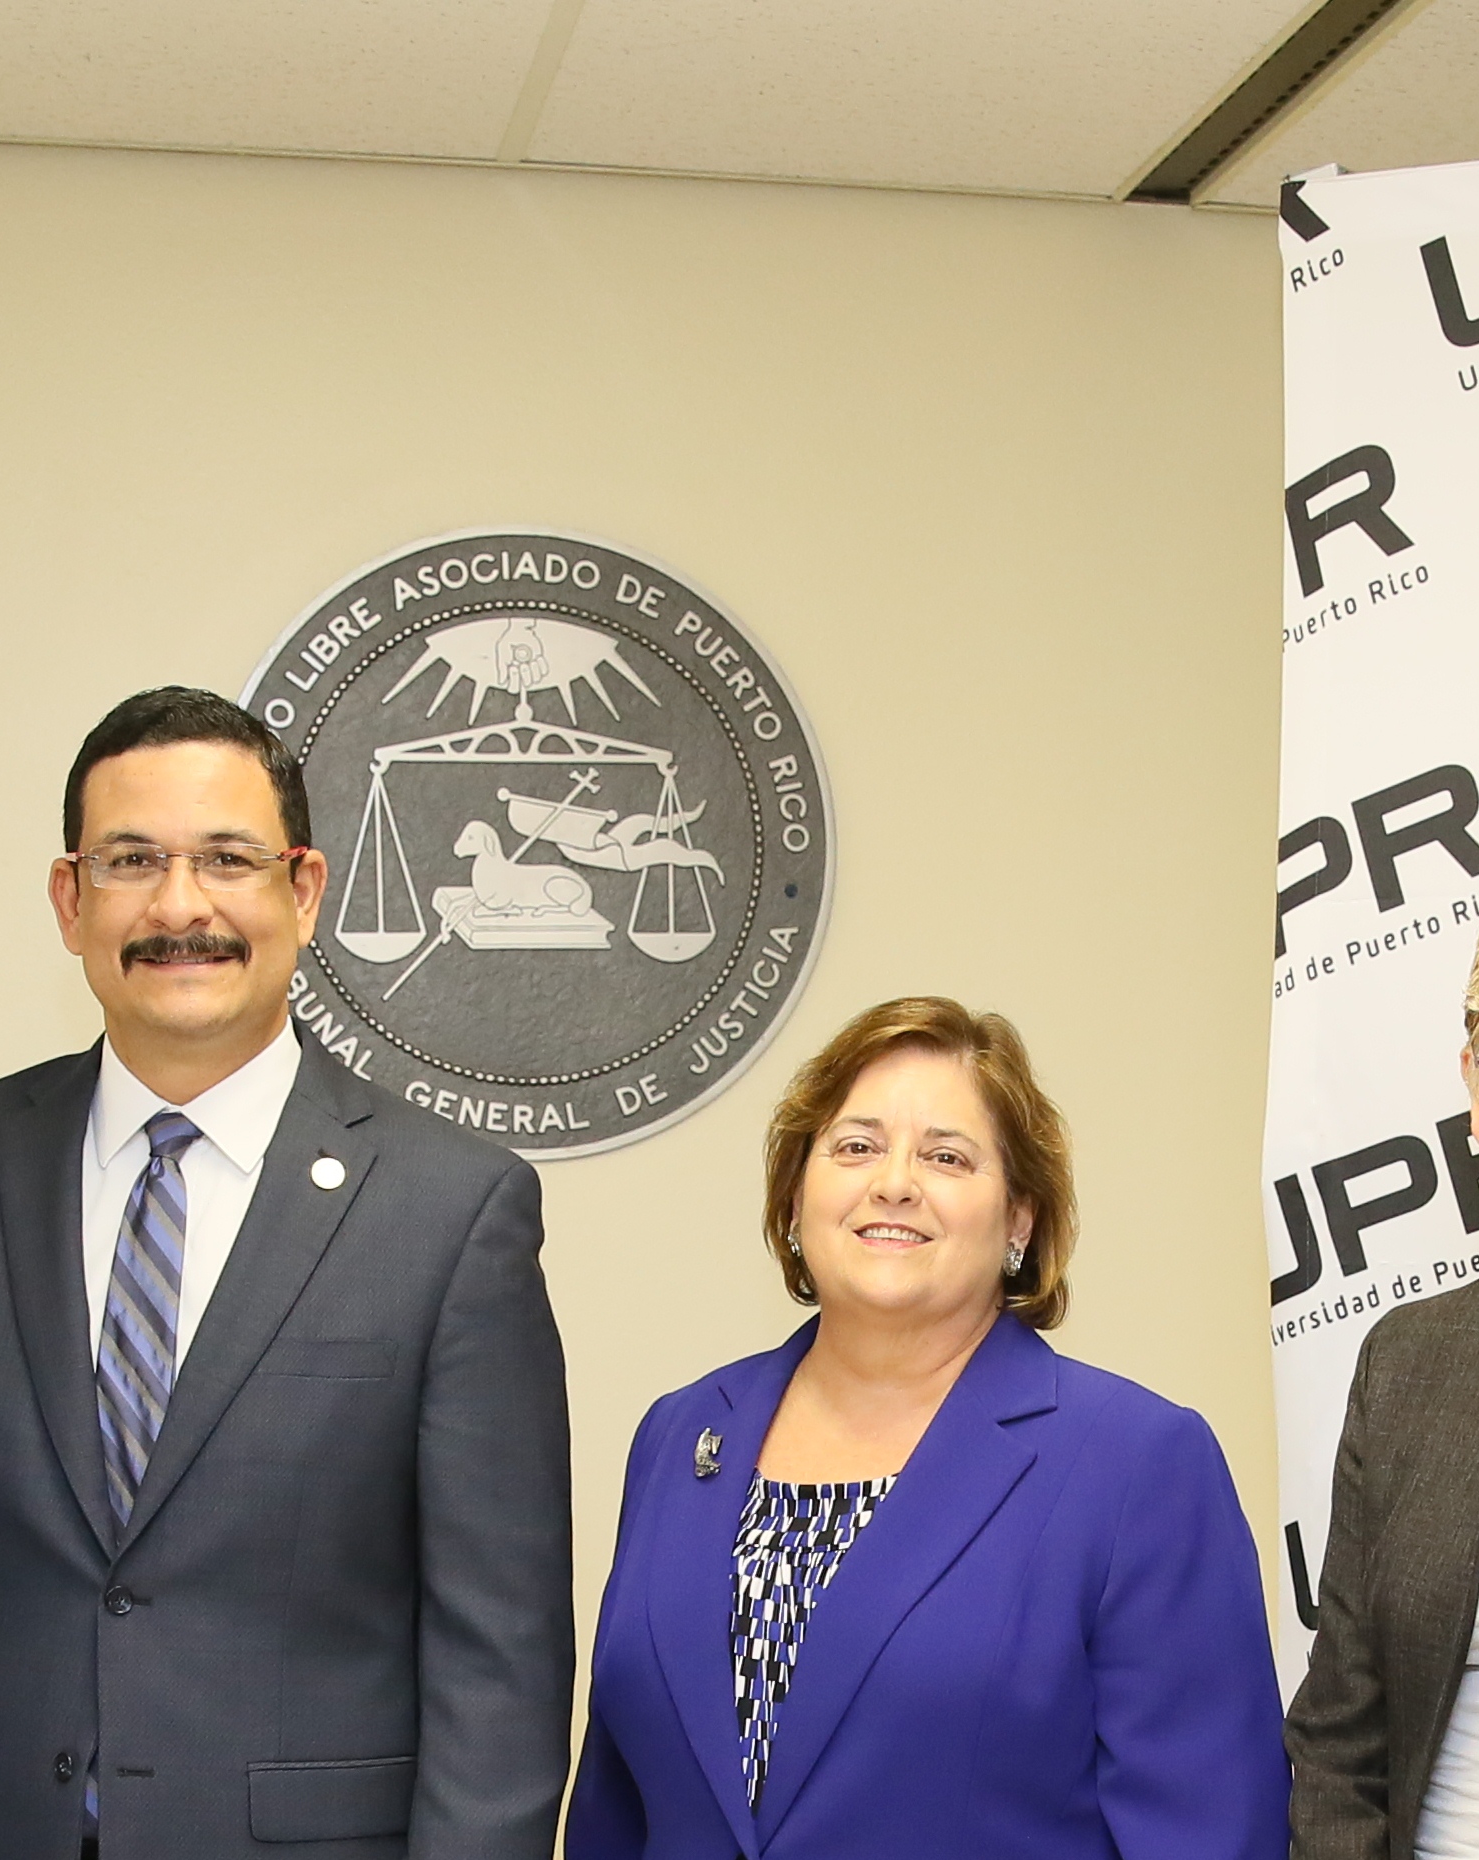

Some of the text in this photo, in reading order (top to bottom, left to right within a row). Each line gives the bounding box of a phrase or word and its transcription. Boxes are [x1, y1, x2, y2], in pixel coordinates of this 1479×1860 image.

[1289, 248, 1345, 292] Rico
[1368, 564, 1430, 605] Rico
[286, 551, 810, 853] LIBRE ASOCIADO DE PUERTO RICO
[1306, 956, 1335, 982] de
[1345, 915, 1441, 965] Puerto
[286, 923, 799, 1133] BUNAL GENERAL DE JUSTICIA
[1272, 1283, 1380, 1347] iversidad
[1392, 1275, 1422, 1299] de
